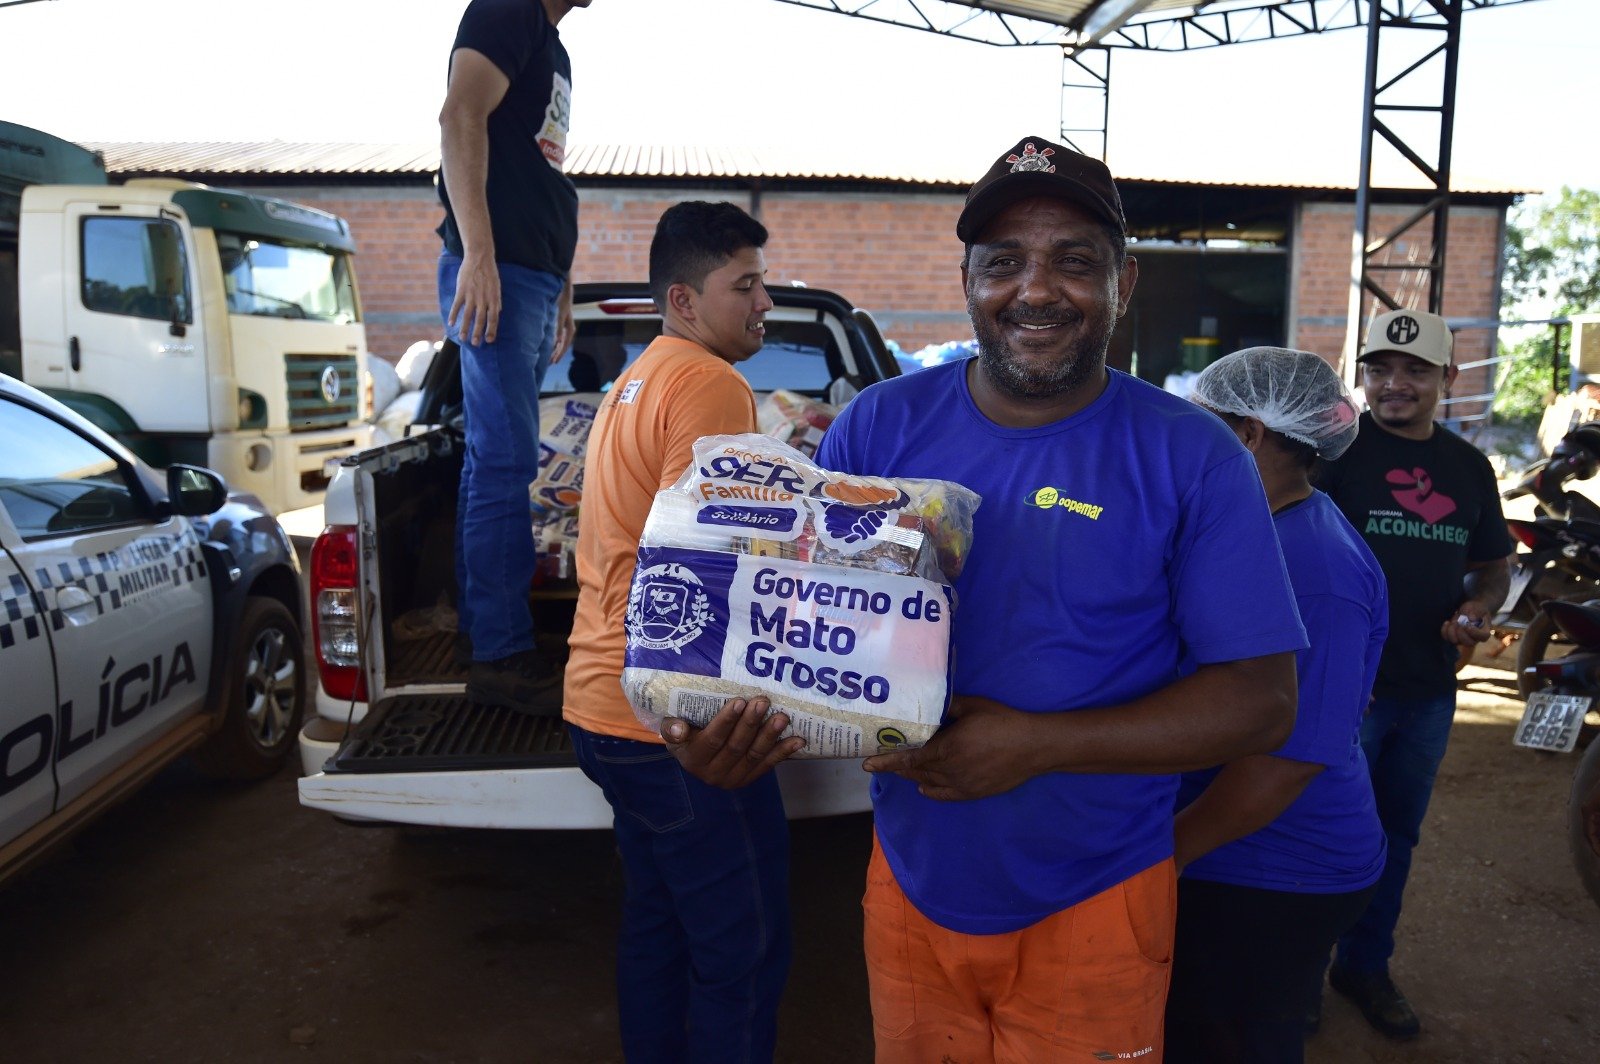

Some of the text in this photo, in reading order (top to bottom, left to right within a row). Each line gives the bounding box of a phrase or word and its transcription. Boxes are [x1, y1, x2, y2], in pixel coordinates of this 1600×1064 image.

[700, 457, 805, 494] SER
[711, 511, 779, 525] Solidário
[1369, 509, 1403, 517] PROGRAMA
[119, 562, 170, 597] MILITAR
[753, 567, 941, 622] Governo de
[750, 602, 856, 656] Mato
[745, 642, 890, 704] Grosso
[1132, 1046, 1153, 1058] BRASIL
